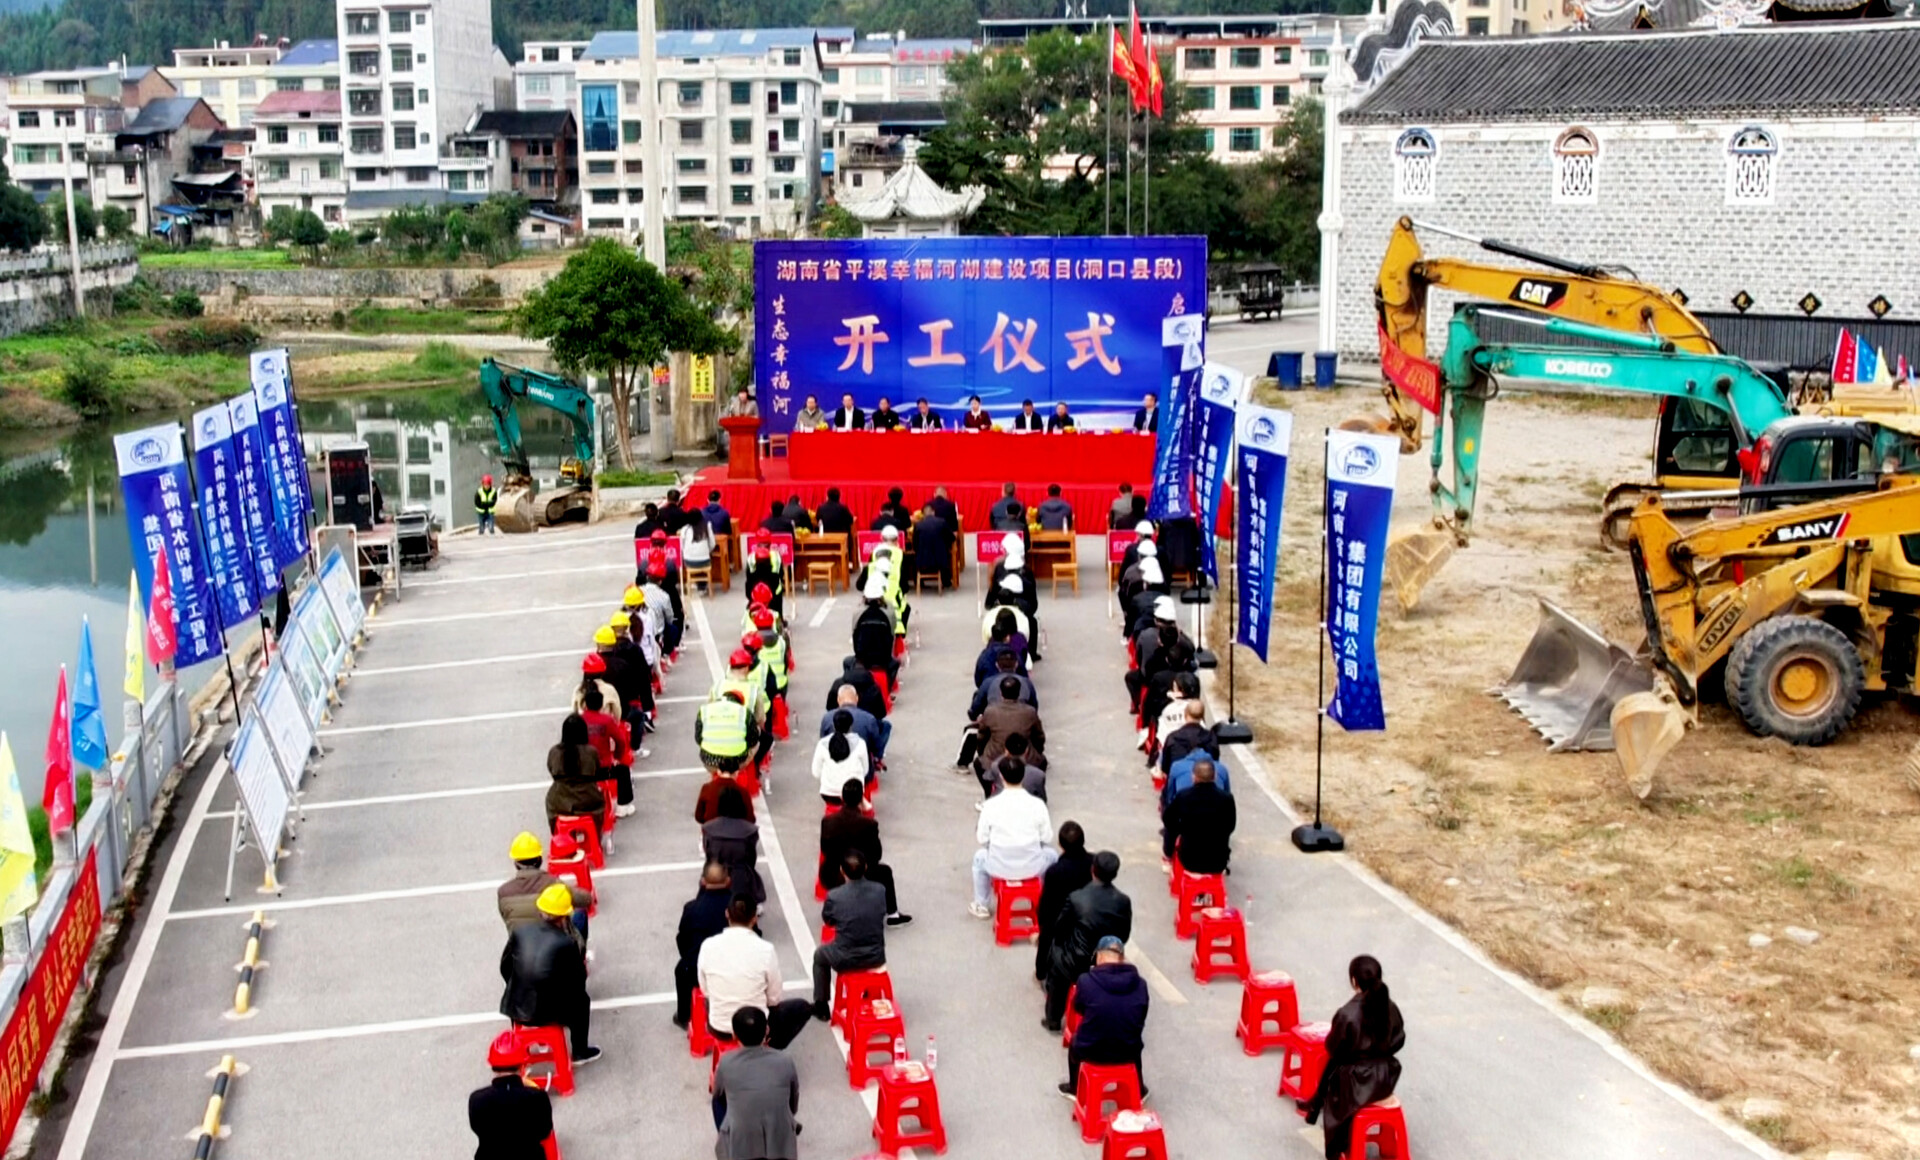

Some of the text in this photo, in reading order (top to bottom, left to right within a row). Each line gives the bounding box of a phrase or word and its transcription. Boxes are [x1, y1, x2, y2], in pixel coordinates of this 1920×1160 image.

[777, 258, 1183, 282] 湖南省平溪幸福河湖建设项目(洞口县段)
[1519, 281, 1552, 305] CAT
[770, 294, 791, 415] 生态幸福河
[833, 311, 1122, 376] 开工仪式
[1545, 359, 1613, 379] KOBELCO
[1778, 521, 1834, 542] SANY
[1343, 539, 1367, 682] 集团有限公司
